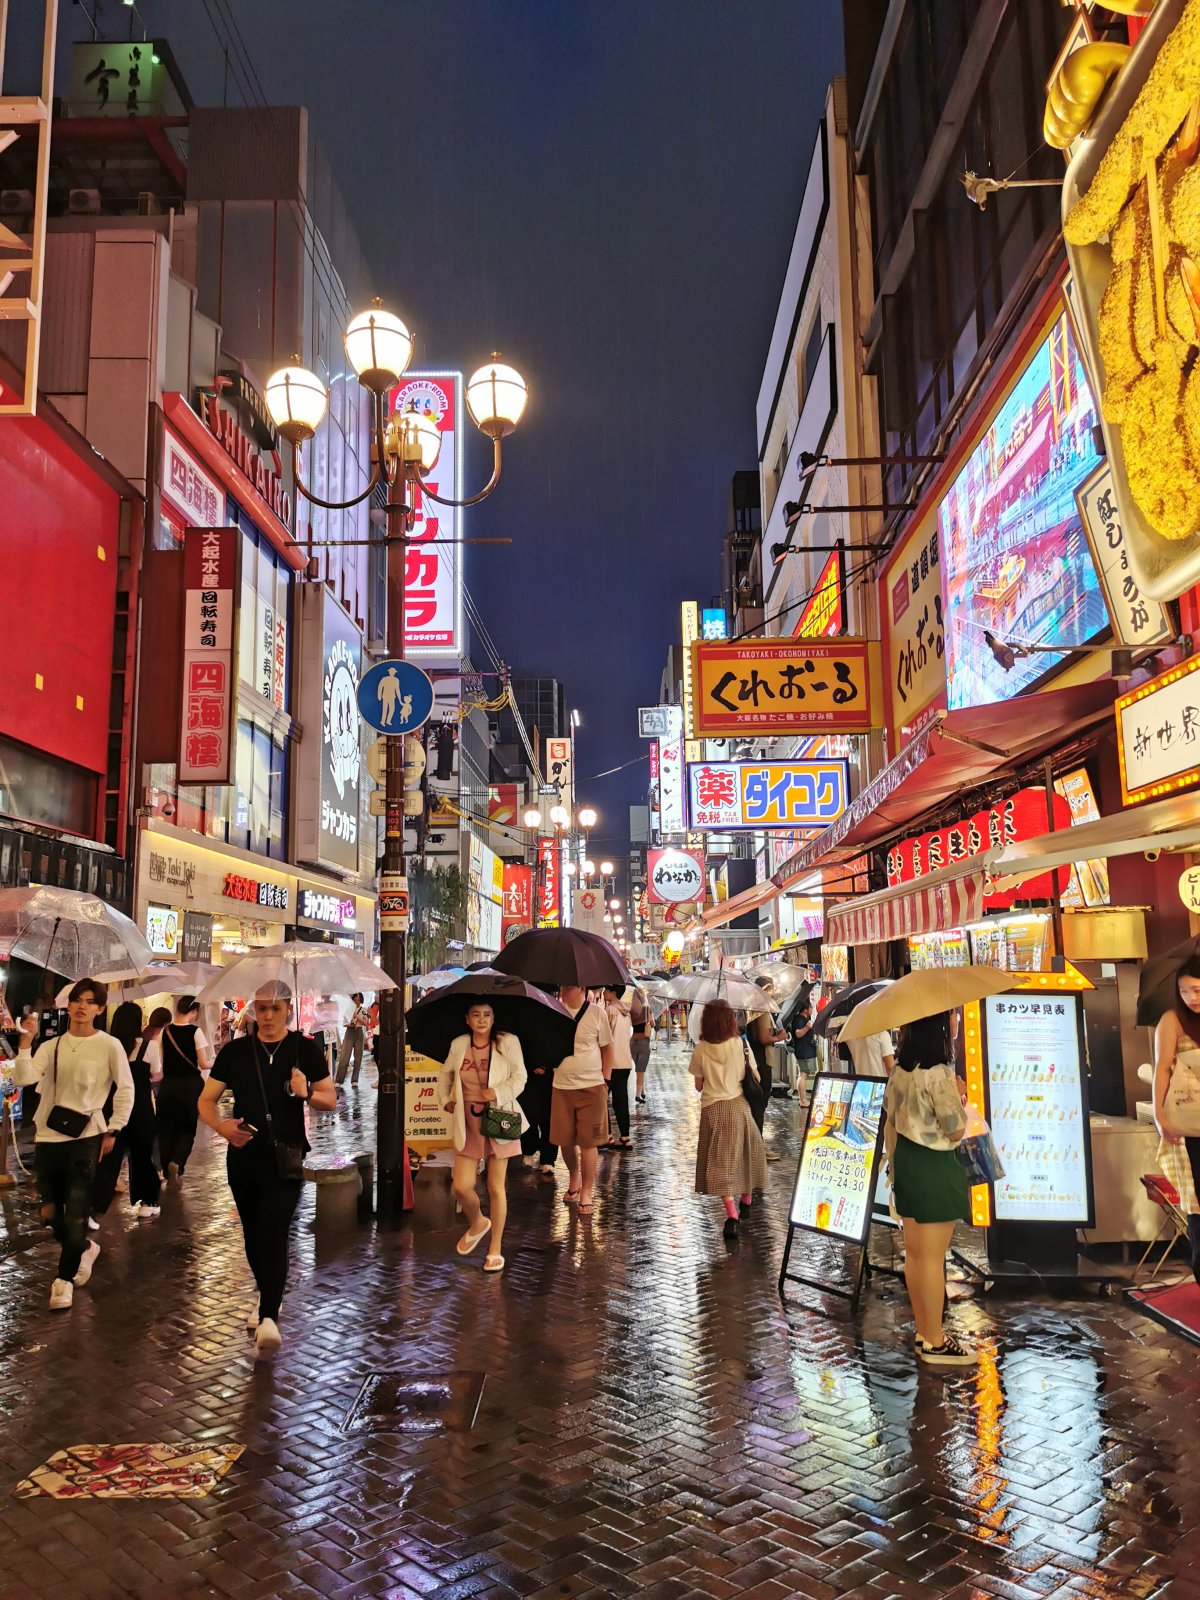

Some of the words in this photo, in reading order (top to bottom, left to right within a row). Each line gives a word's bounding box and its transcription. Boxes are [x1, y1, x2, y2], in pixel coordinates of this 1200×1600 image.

[202, 532, 220, 588] 大起水産
[200, 591, 217, 647] 回転寿司
[711, 660, 857, 711] くれおーる
[1133, 706, 1200, 766] 新世界
[698, 767, 735, 807] 薬
[746, 771, 840, 818] ダイコク
[322, 800, 357, 844] ジャンカラ
[697, 812, 721, 823] 免税
[655, 868, 697, 884] わなか
[996, 1003, 1065, 1015] 串カツ早見表
[418, 1087, 434, 1098] JTB
